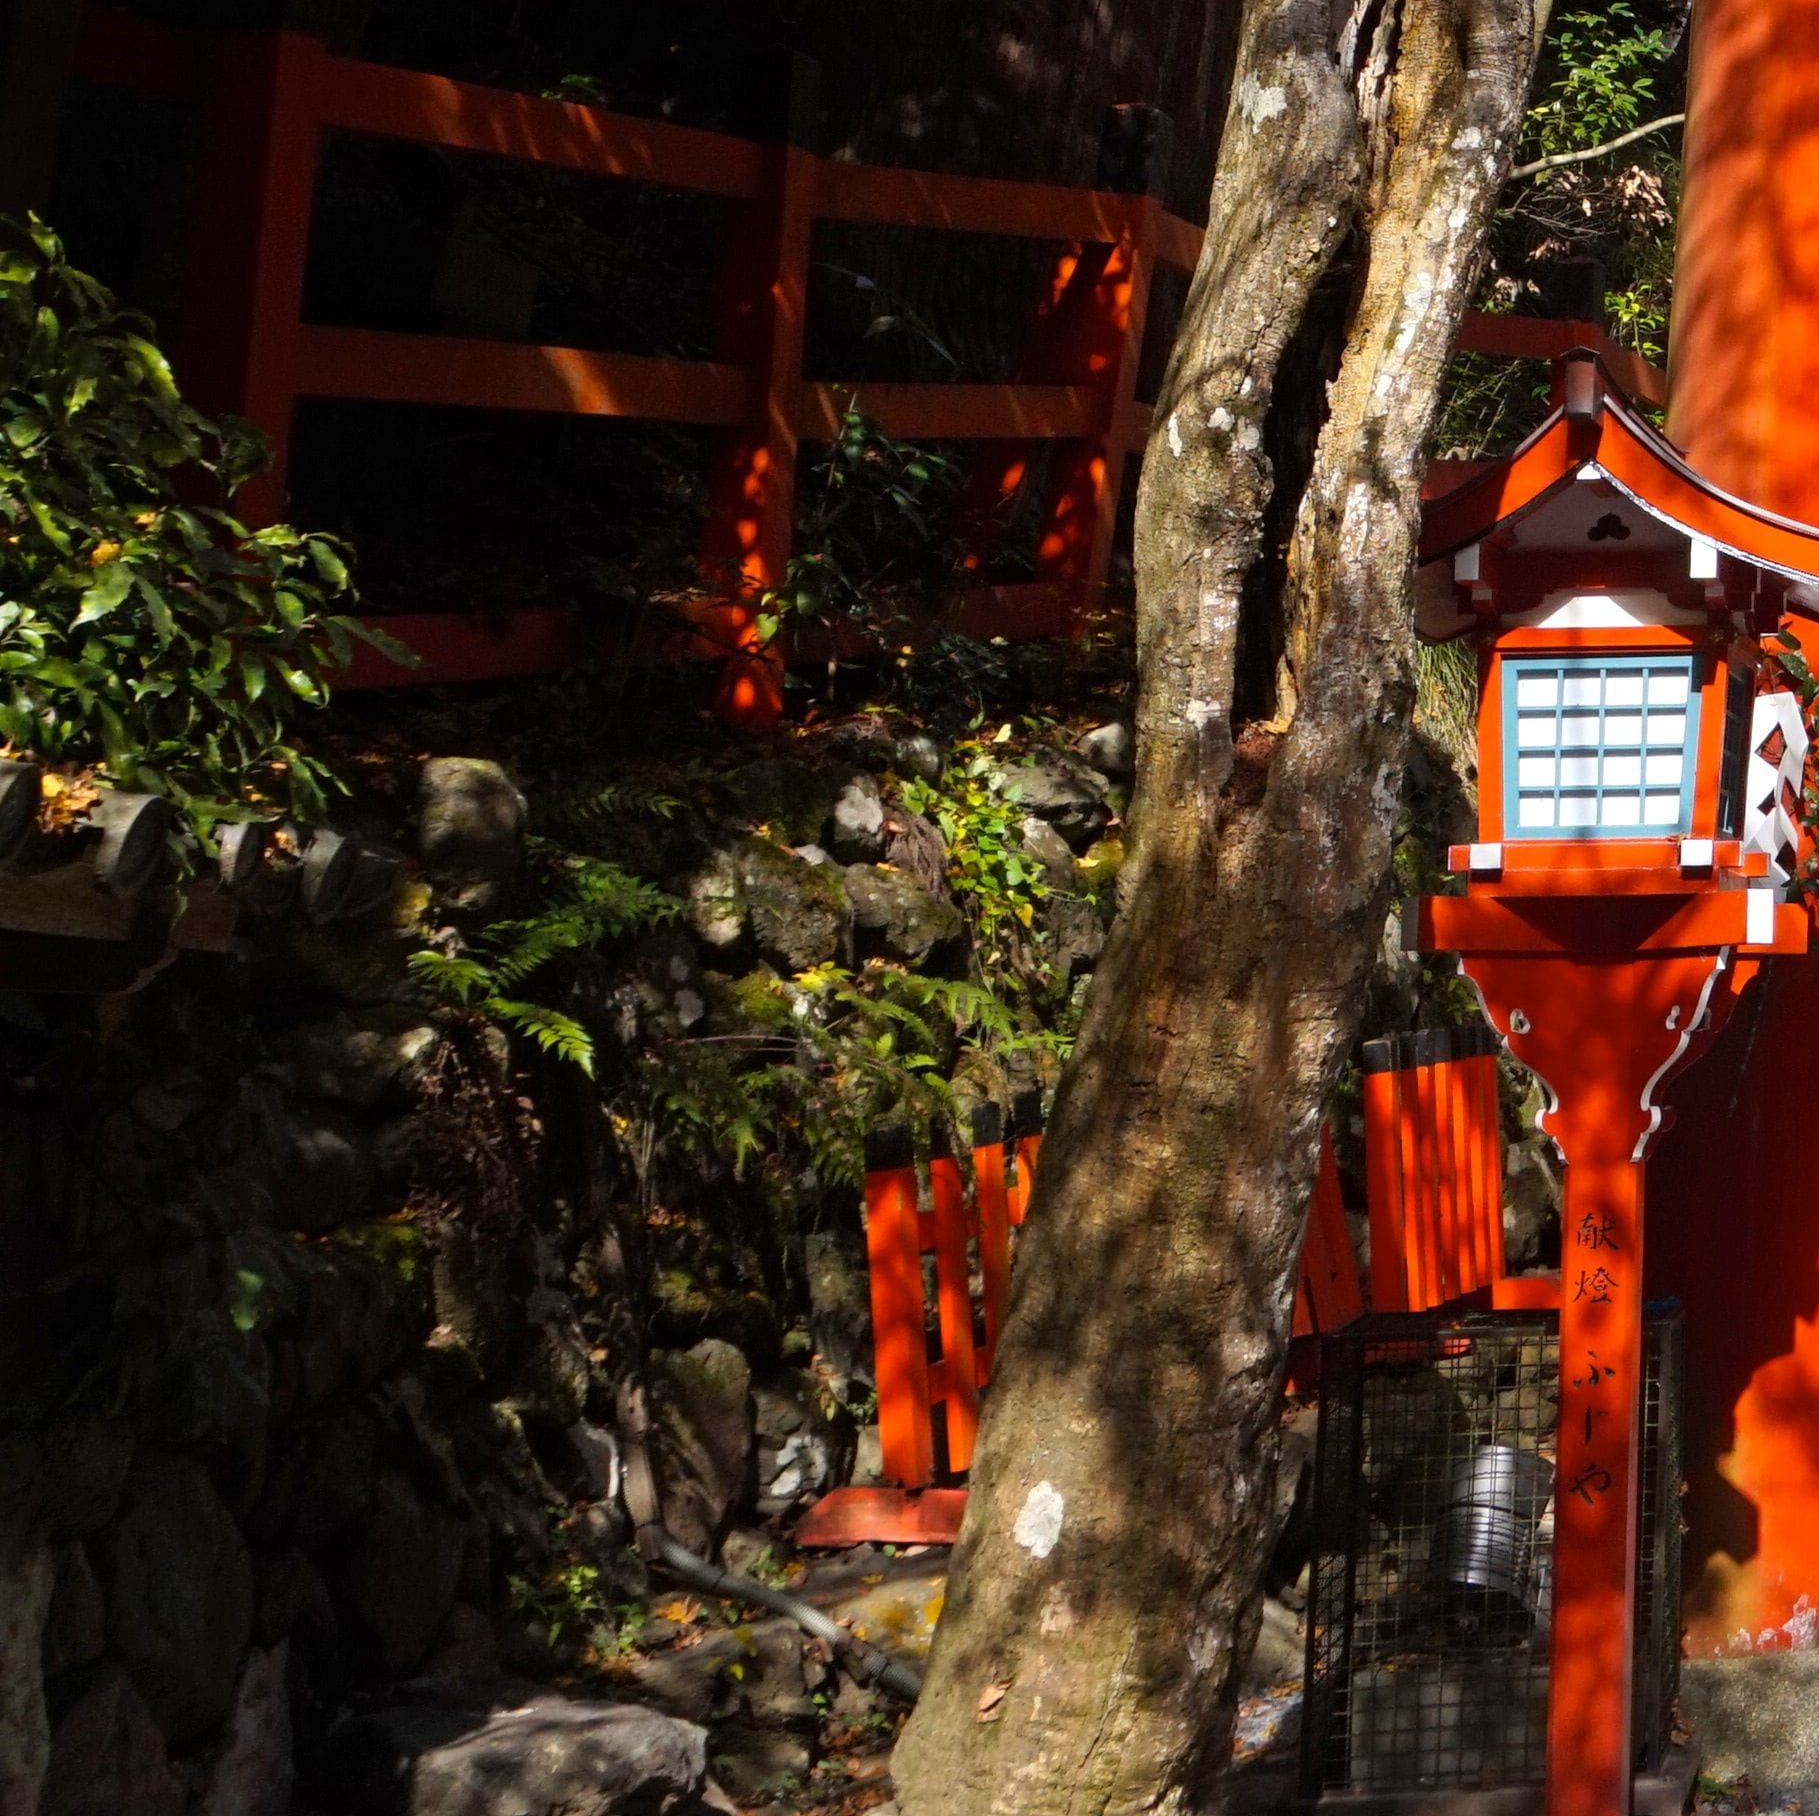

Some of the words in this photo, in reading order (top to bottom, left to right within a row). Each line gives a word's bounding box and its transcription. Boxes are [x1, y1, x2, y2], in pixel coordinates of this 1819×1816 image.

[1573, 1212, 1621, 1304] 献燈
[1568, 1349, 1616, 1508] ふじや
